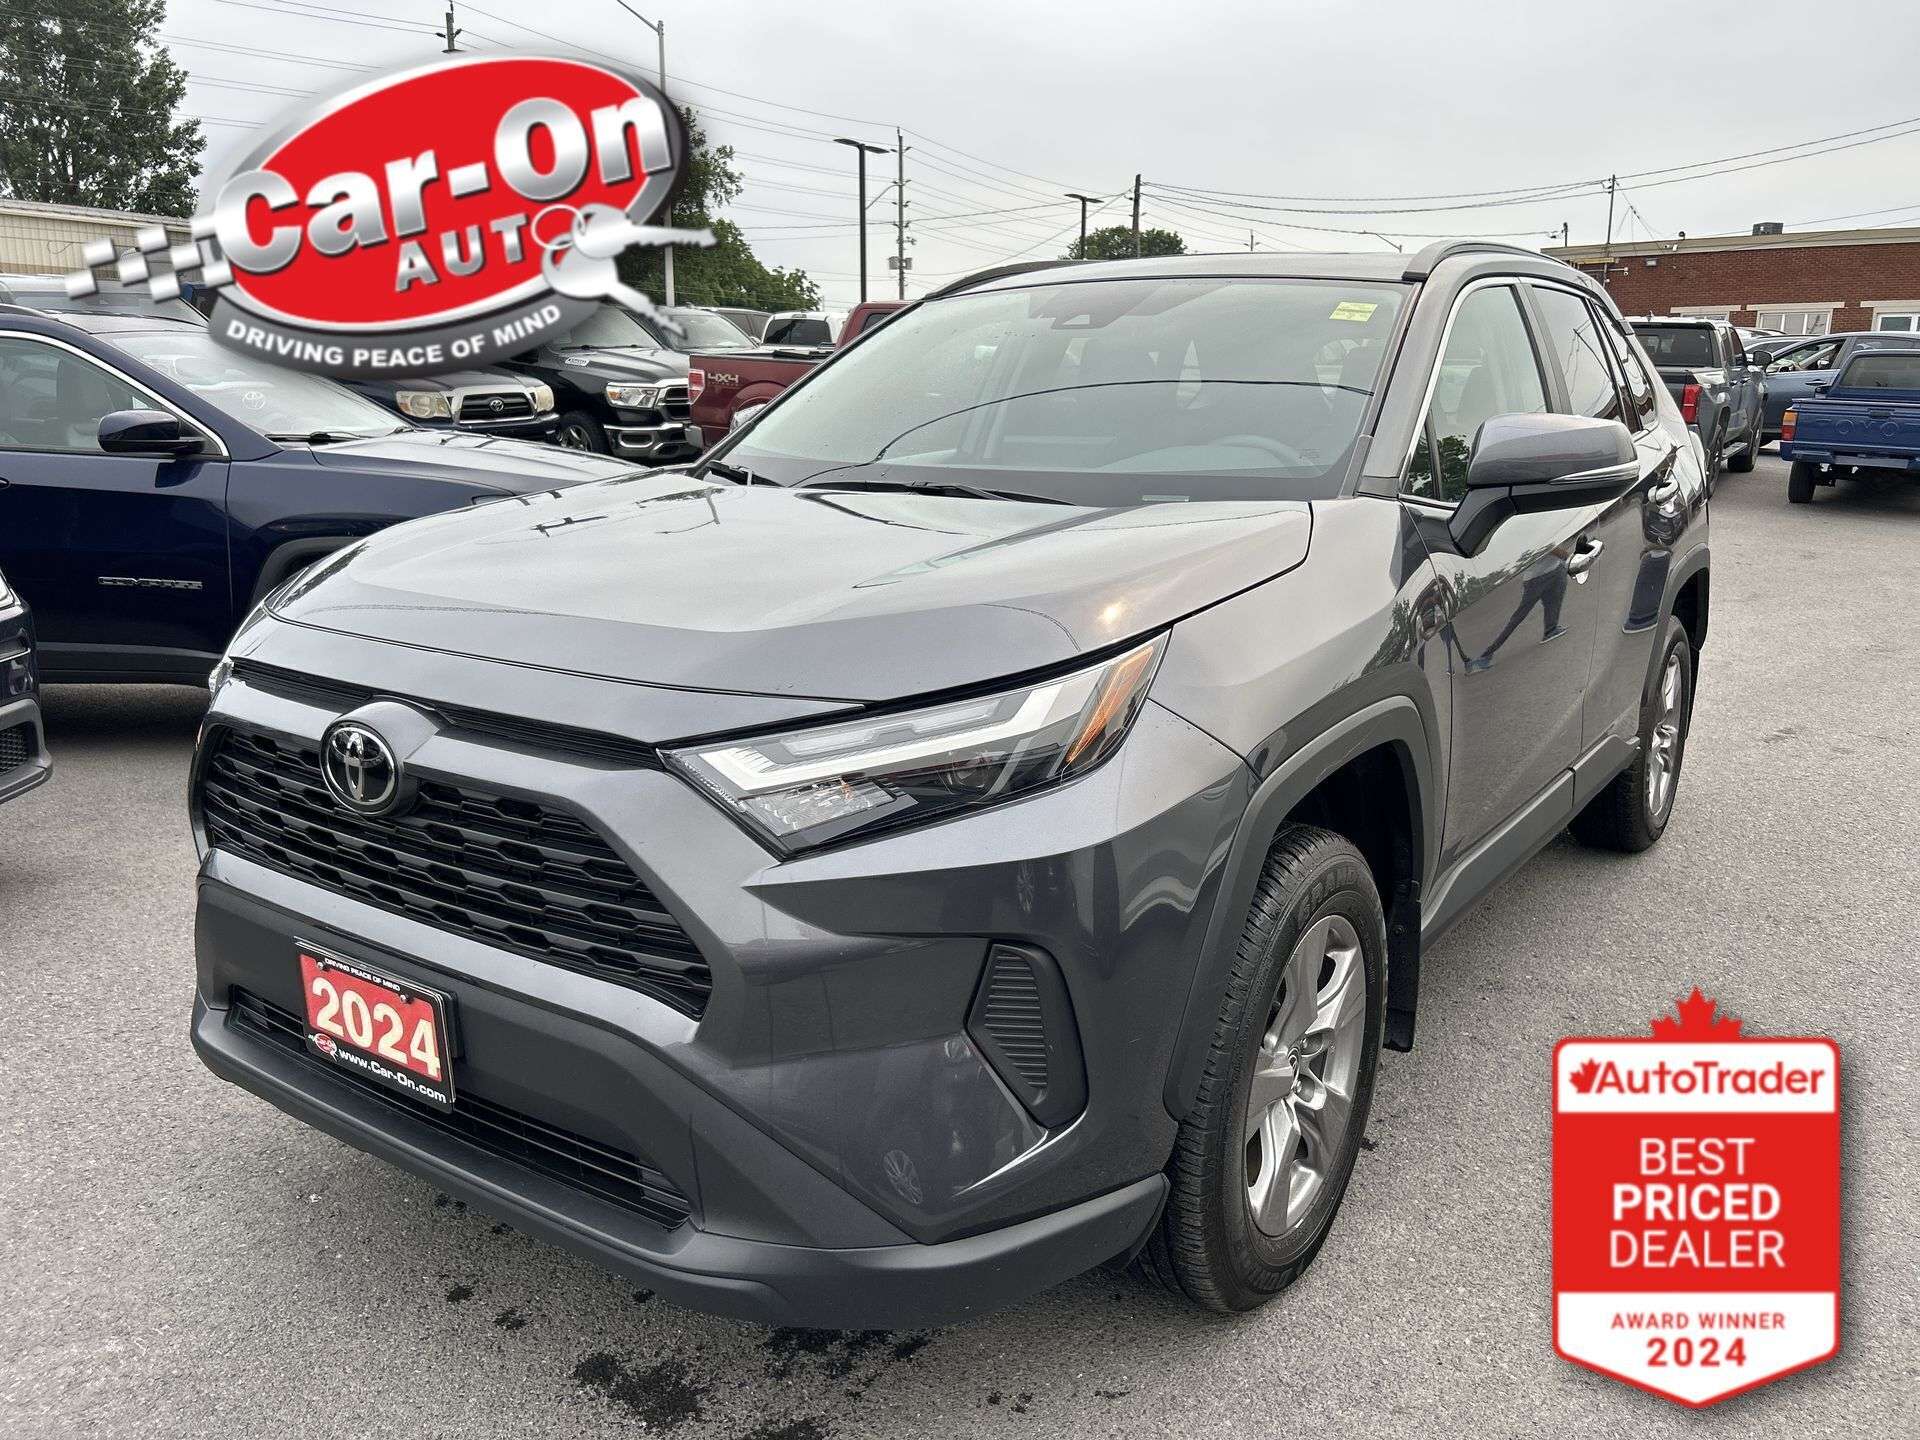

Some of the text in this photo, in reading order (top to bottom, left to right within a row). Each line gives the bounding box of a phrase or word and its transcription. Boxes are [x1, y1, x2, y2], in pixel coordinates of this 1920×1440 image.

[324, 957, 401, 992] DRIVING PEACE OF MIND
[311, 977, 441, 1078] 2024
[338, 1048, 447, 1104] www.Car-On.com
